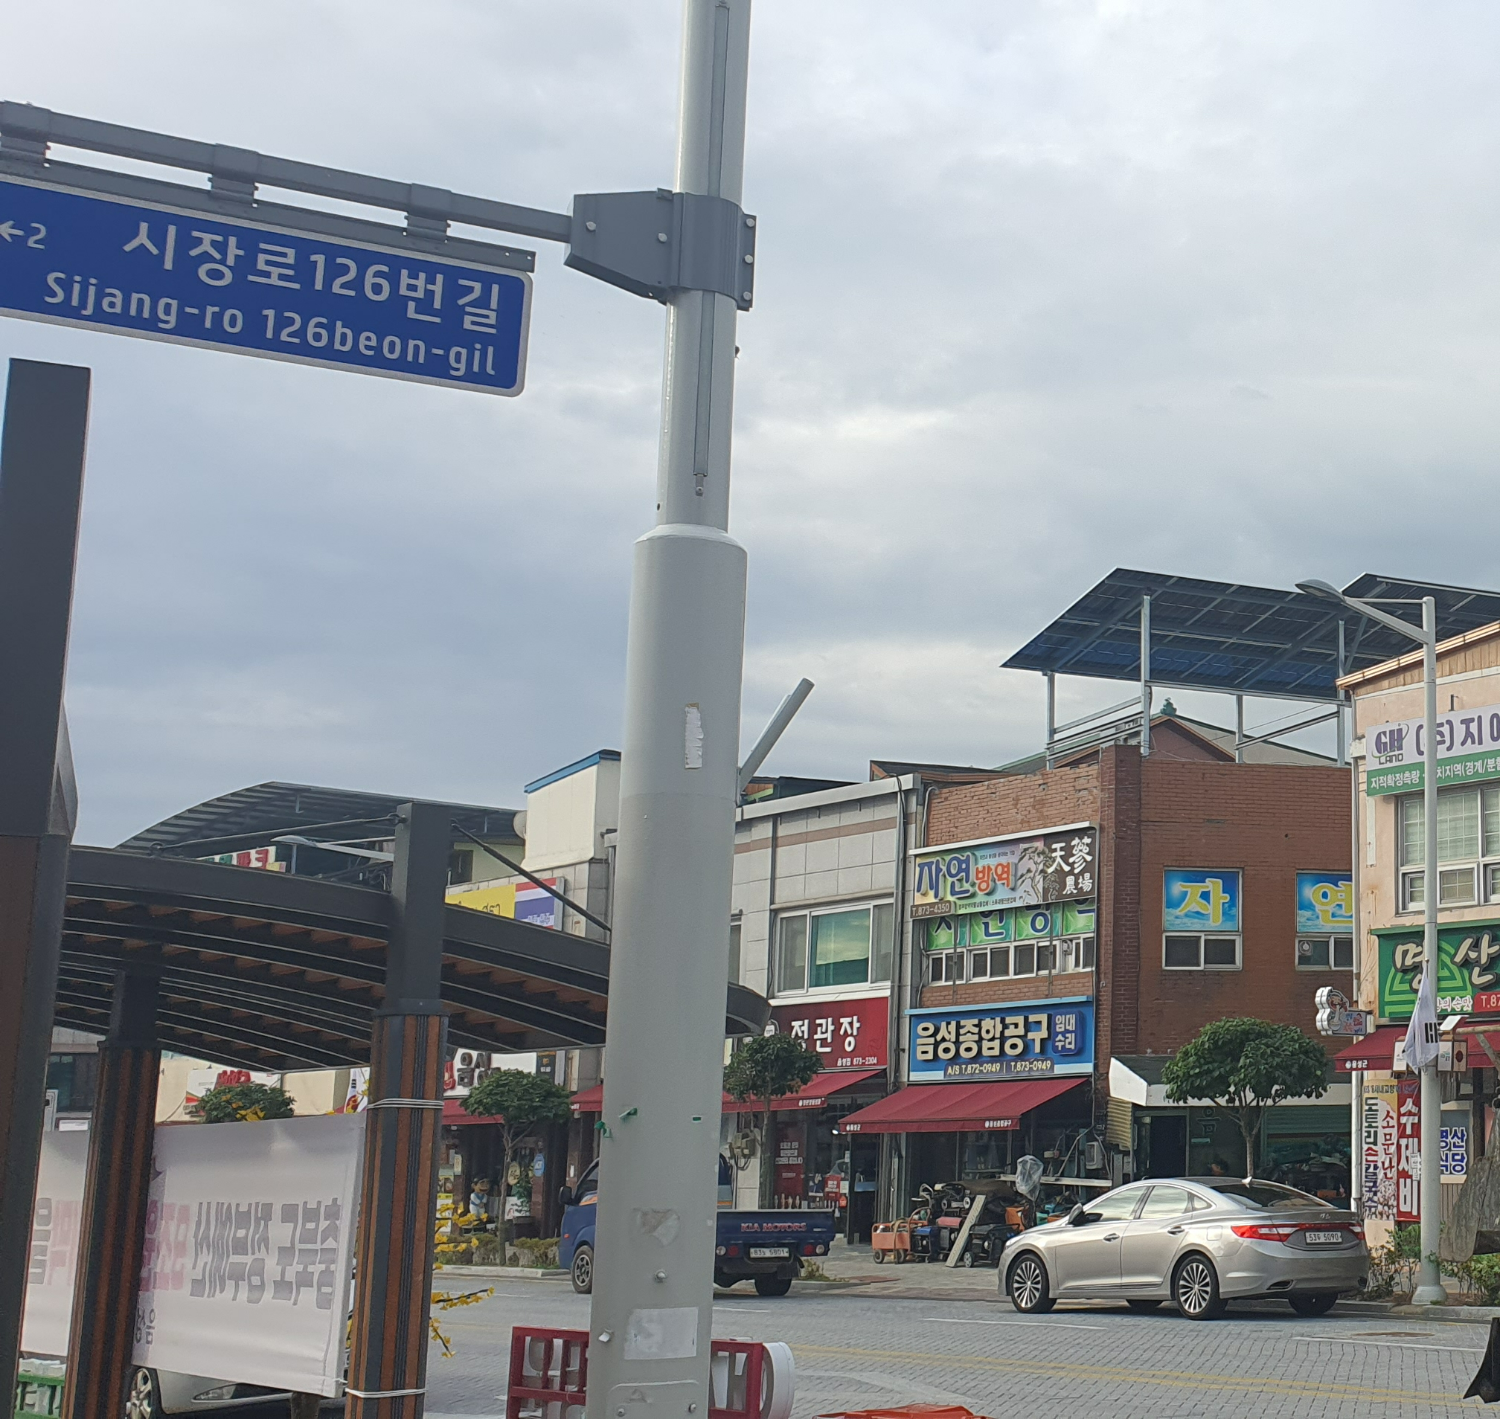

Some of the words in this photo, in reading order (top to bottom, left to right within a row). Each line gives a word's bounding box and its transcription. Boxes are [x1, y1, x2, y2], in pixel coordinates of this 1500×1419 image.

[122, 221, 501, 336] 시장로126번길
[44, 271, 244, 335] Sijang-ro
[260, 307, 497, 378] 126beon-gil
[1370, 771, 1420, 790] 지적확정측량
[915, 852, 972, 901] 자연
[974, 861, 1013, 894] 방역
[911, 902, 950, 917] T.873-4350
[1177, 877, 1230, 926] 자
[1310, 880, 1353, 926] 연
[790, 1015, 861, 1053] 정관장
[915, 1013, 1049, 1061] 음성종합공구
[1054, 1032, 1076, 1051] 수리
[1055, 1013, 1076, 1032] 임대
[1010, 1060, 1051, 1073] T.873-0949
[1381, 1109, 1396, 1180] 소문난
[1398, 1097, 1420, 1217] 수제비
[741, 1222, 761, 1232] KIA
[762, 1221, 807, 1232] MOTORS
